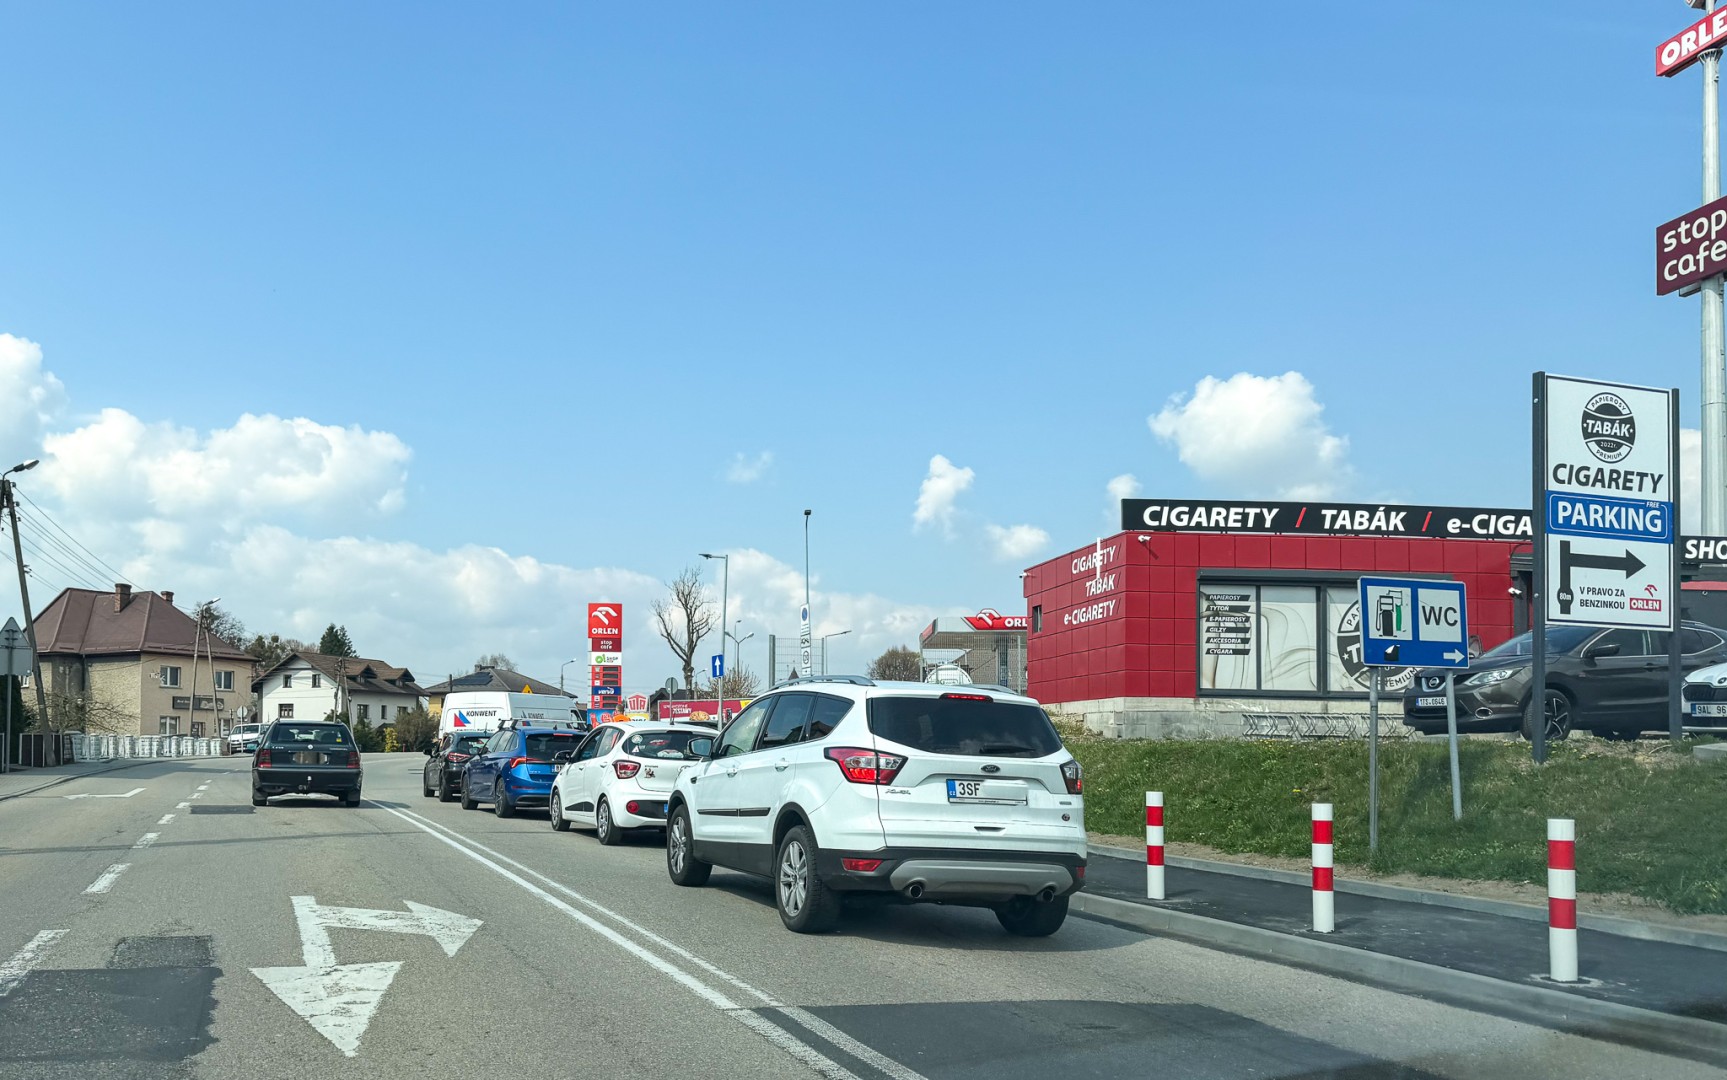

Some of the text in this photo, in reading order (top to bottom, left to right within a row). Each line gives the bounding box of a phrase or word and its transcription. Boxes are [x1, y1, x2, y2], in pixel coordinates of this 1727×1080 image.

[1661, 9, 1727, 66] ORLE
[1663, 208, 1727, 253] stop
[1663, 239, 1727, 282] cafe
[1591, 396, 1626, 411] PAPIEROSY
[1586, 419, 1631, 438] TABÁK
[1596, 449, 1623, 460] PREMIUM
[1552, 463, 1664, 494] CIGARETY
[1646, 501, 1660, 509] FREE
[1143, 505, 1280, 529] CIGARETY
[1320, 506, 1407, 532] TABÁK
[1446, 514, 1533, 536] e-CIGA
[1557, 501, 1662, 533] PARKING
[1684, 539, 1727, 560] SHO
[1085, 571, 1116, 597] TABÁK
[1579, 586, 1626, 597] V PRAVO ZA
[1559, 592, 1571, 601] 80m
[1579, 599, 1626, 609] BENZINKOU
[1631, 600, 1660, 610] ORLEN
[1064, 599, 1116, 625] e-CIGARETY
[1421, 605, 1458, 627] WC
[1004, 618, 1028, 627] ORL
[1697, 705, 1711, 714] 9AL
[958, 783, 981, 796] 3SF
